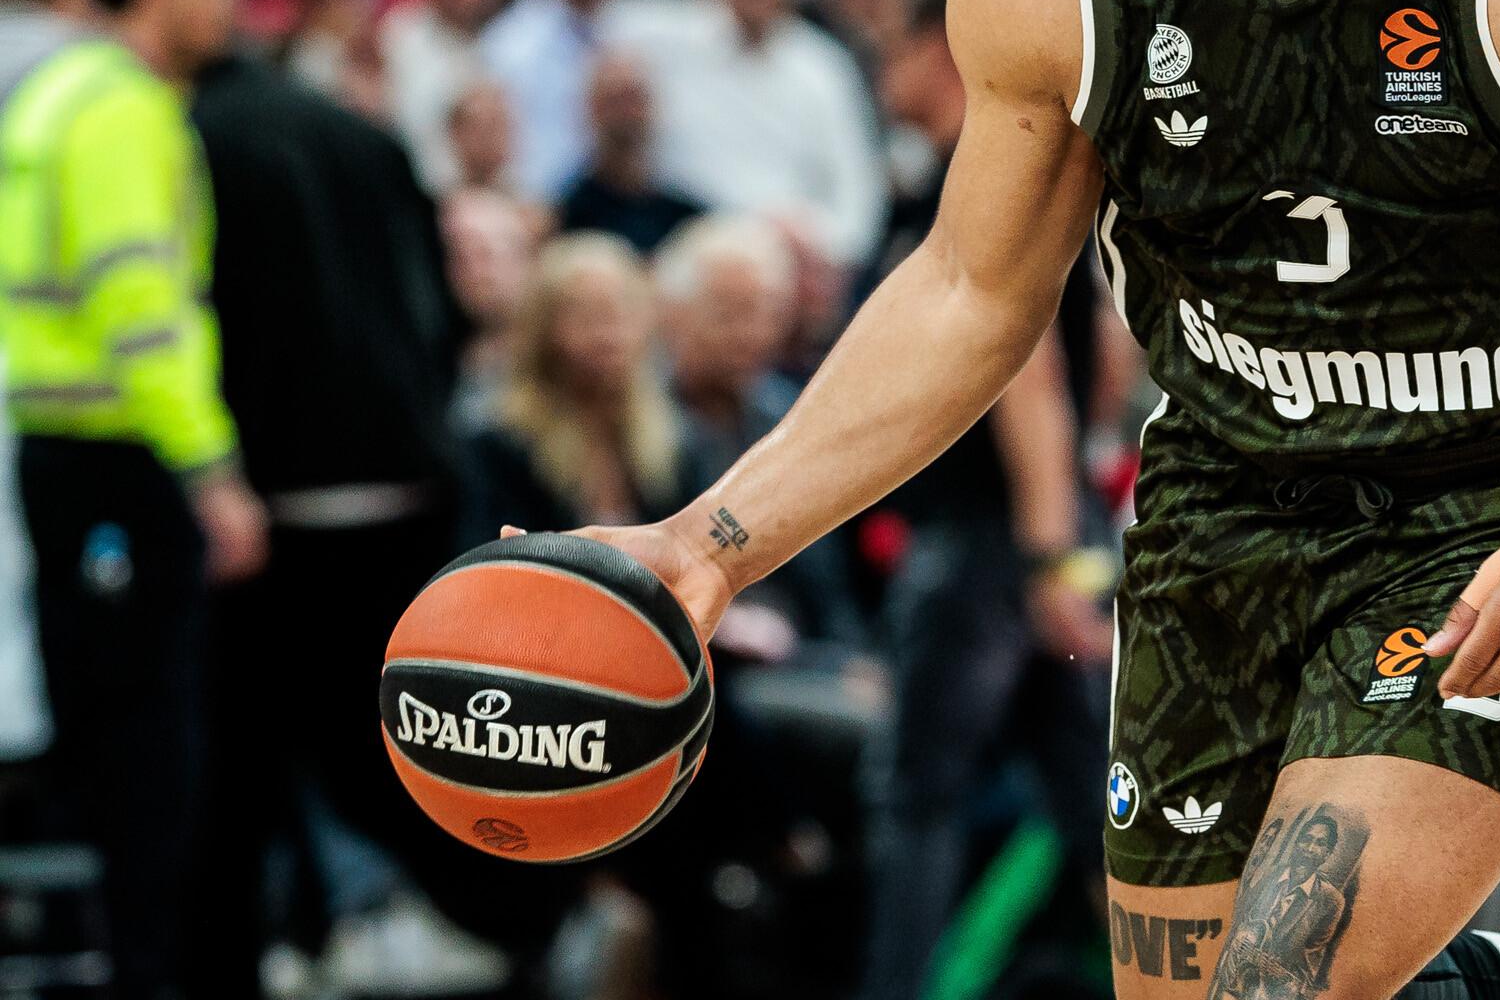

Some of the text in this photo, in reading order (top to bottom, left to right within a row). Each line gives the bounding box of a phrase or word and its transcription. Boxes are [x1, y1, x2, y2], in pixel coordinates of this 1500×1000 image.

[1385, 71, 1442, 82] TURKISH
[1143, 80, 1201, 101] BASKETBALL
[1385, 82, 1442, 93] AIRLINES
[1385, 93, 1443, 104] EuroLeague
[1376, 115, 1468, 136] oneteam
[1371, 675, 1418, 689] TURKISH
[1367, 684, 1415, 697] AIRLINES
[397, 691, 607, 773] SPALDING
